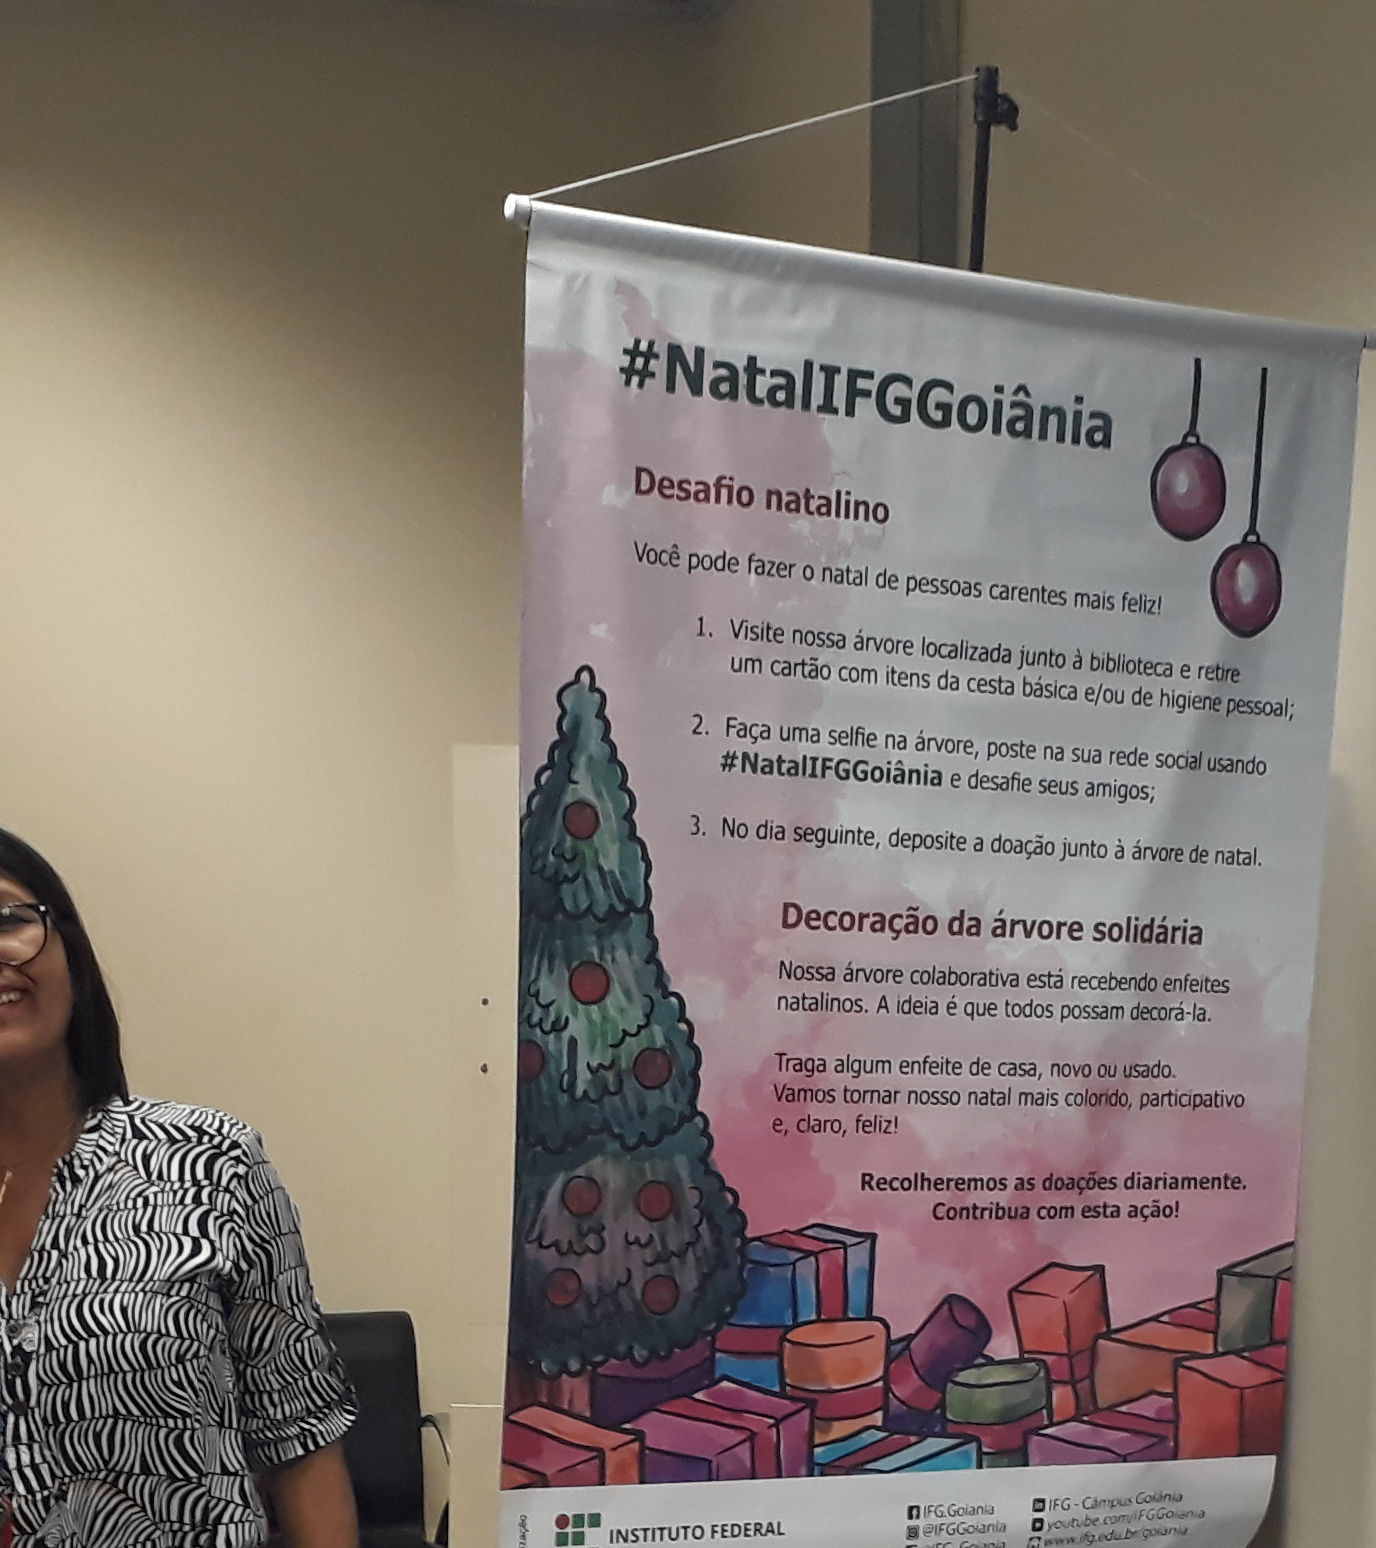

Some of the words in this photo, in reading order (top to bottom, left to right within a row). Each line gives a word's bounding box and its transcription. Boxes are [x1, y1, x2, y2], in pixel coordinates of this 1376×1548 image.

[619, 337, 1114, 449] #NatalIFGGoiânia
[634, 465, 754, 509] Desafio
[765, 485, 891, 524] natalino
[633, 541, 681, 568] Você
[688, 549, 740, 575] pode
[747, 552, 796, 580] fazer
[803, 564, 815, 582] o
[822, 564, 869, 588] natal
[875, 568, 899, 591] de
[906, 574, 982, 599] pessoas
[989, 580, 1067, 606] carentes
[1074, 589, 1115, 611] mais
[1121, 593, 1163, 615] feliz!
[696, 615, 713, 638] 1.
[730, 618, 785, 644] Visite
[792, 627, 846, 650] nossa
[853, 628, 914, 656] árvore
[921, 636, 1012, 664] localizada
[1018, 645, 1066, 670] junto
[1072, 649, 1083, 671] à
[1090, 652, 1173, 678] biblioteca
[1180, 663, 1191, 680] e
[1197, 663, 1241, 684] retire
[730, 656, 762, 674] um
[770, 657, 831, 681] cartão
[838, 665, 878, 685] com
[885, 666, 930, 689] itens
[937, 669, 960, 692] da
[967, 674, 1015, 696] cesta
[1023, 676, 1077, 700] básica
[1085, 683, 1125, 706] e/ou
[1131, 686, 1153, 707] de
[1160, 689, 1221, 714] higiene
[1226, 697, 1295, 721] pessoal;
[692, 714, 709, 735] 2.
[726, 717, 771, 744] Faça
[779, 725, 821, 745] uma
[828, 725, 878, 748] selfie
[885, 733, 907, 751] na
[915, 730, 979, 760] árvore,
[987, 740, 1036, 761] poste
[1043, 744, 1064, 762] na
[1072, 747, 1102, 765] sua
[1109, 747, 1149, 768] rede
[1155, 751, 1202, 771] social
[1208, 755, 1267, 776] usando
[720, 750, 943, 787] #NatalIFGGoiânia
[950, 772, 962, 789] e
[968, 769, 1032, 793] desafie
[1038, 776, 1079, 796] seus
[1085, 779, 1155, 804] amigos;
[690, 815, 706, 837] 3.
[722, 816, 748, 838] No
[756, 820, 785, 841] dia
[793, 824, 880, 849] seguinte,
[888, 827, 967, 852] deposite
[973, 835, 983, 852] a
[991, 833, 1055, 860] doação
[1059, 837, 1108, 862] junto
[1114, 838, 1125, 860] à
[1132, 838, 1184, 862] árvore
[1189, 844, 1209, 864] de
[1215, 847, 1262, 867] natal.
[781, 902, 938, 941] Decoração
[948, 909, 982, 938] da
[990, 909, 1084, 941] árvore
[1092, 915, 1204, 946] solidária
[778, 960, 835, 982] Nossa
[843, 962, 903, 985] árvore
[910, 966, 1020, 989] colaborativa
[1026, 968, 1064, 990] está
[1071, 971, 1157, 993] recebendo
[1163, 973, 1230, 994] enfeites
[777, 992, 869, 1014] natalinos.
[876, 995, 890, 1015] A
[896, 995, 939, 1016] ideia
[946, 996, 958, 1016] é
[964, 999, 998, 1021] que
[1004, 999, 1054, 1019] todos
[1060, 1002, 1125, 1023] possam
[1130, 1001, 1212, 1022] decorá-la.
[774, 1053, 827, 1078] Traga
[834, 1054, 892, 1078] algum
[899, 1056, 962, 1077] enfeite
[969, 1057, 991, 1077] de
[998, 1062, 1042, 1081] casa,
[1050, 1062, 1092, 1079] novo
[1097, 1063, 1117, 1079] ou
[1123, 1060, 1176, 1080] usado.
[774, 1084, 836, 1104] Vamos
[843, 1085, 901, 1105] tornar
[907, 1088, 961, 1106] nosso
[968, 1087, 1011, 1106] natal
[1018, 1088, 1058, 1107] mais
[1064, 1088, 1132, 1110] colorido,
[1139, 1089, 1246, 1110] participativo
[772, 1116, 788, 1137] e,
[796, 1114, 847, 1138] claro,
[855, 1114, 899, 1135] feliz!
[860, 1172, 1008, 1193] Recolheremos
[1014, 1177, 1035, 1192] as
[1042, 1171, 1118, 1195] doações
[1124, 1171, 1247, 1192] diariamente.
[932, 1201, 1030, 1221] Contribua
[1037, 1204, 1074, 1220] com
[1081, 1202, 1121, 1219] esta
[1127, 1200, 1180, 1222] ação!
[1048, 1498, 1071, 1512] IFG
[609, 1525, 705, 1545] INSTITUTO
[710, 1521, 786, 1540] FEDERAL
